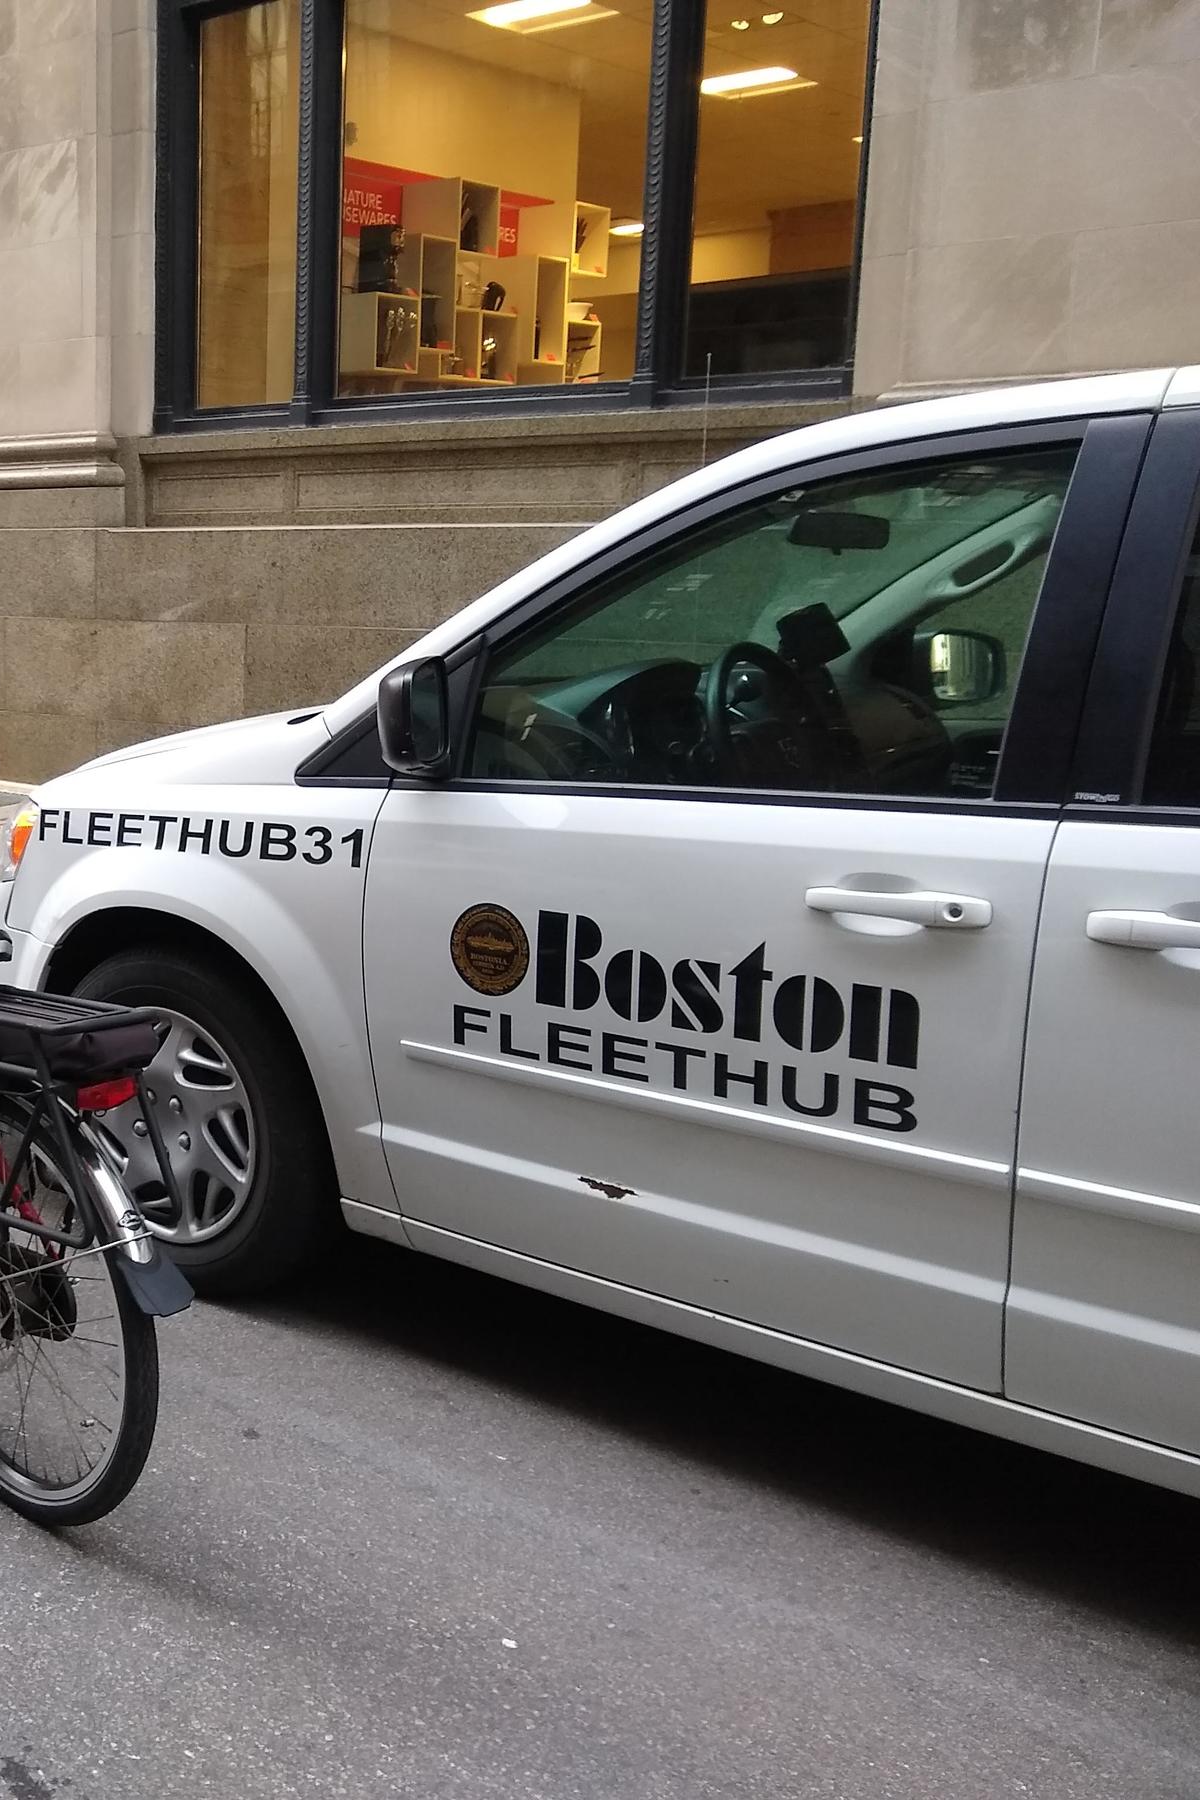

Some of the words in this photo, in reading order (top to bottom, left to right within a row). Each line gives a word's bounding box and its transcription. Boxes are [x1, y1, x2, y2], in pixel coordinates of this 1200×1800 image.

[38, 808, 364, 868] FLEETHUB31
[536, 909, 920, 1069] Boston
[453, 1003, 918, 1133] FLEETHUB
